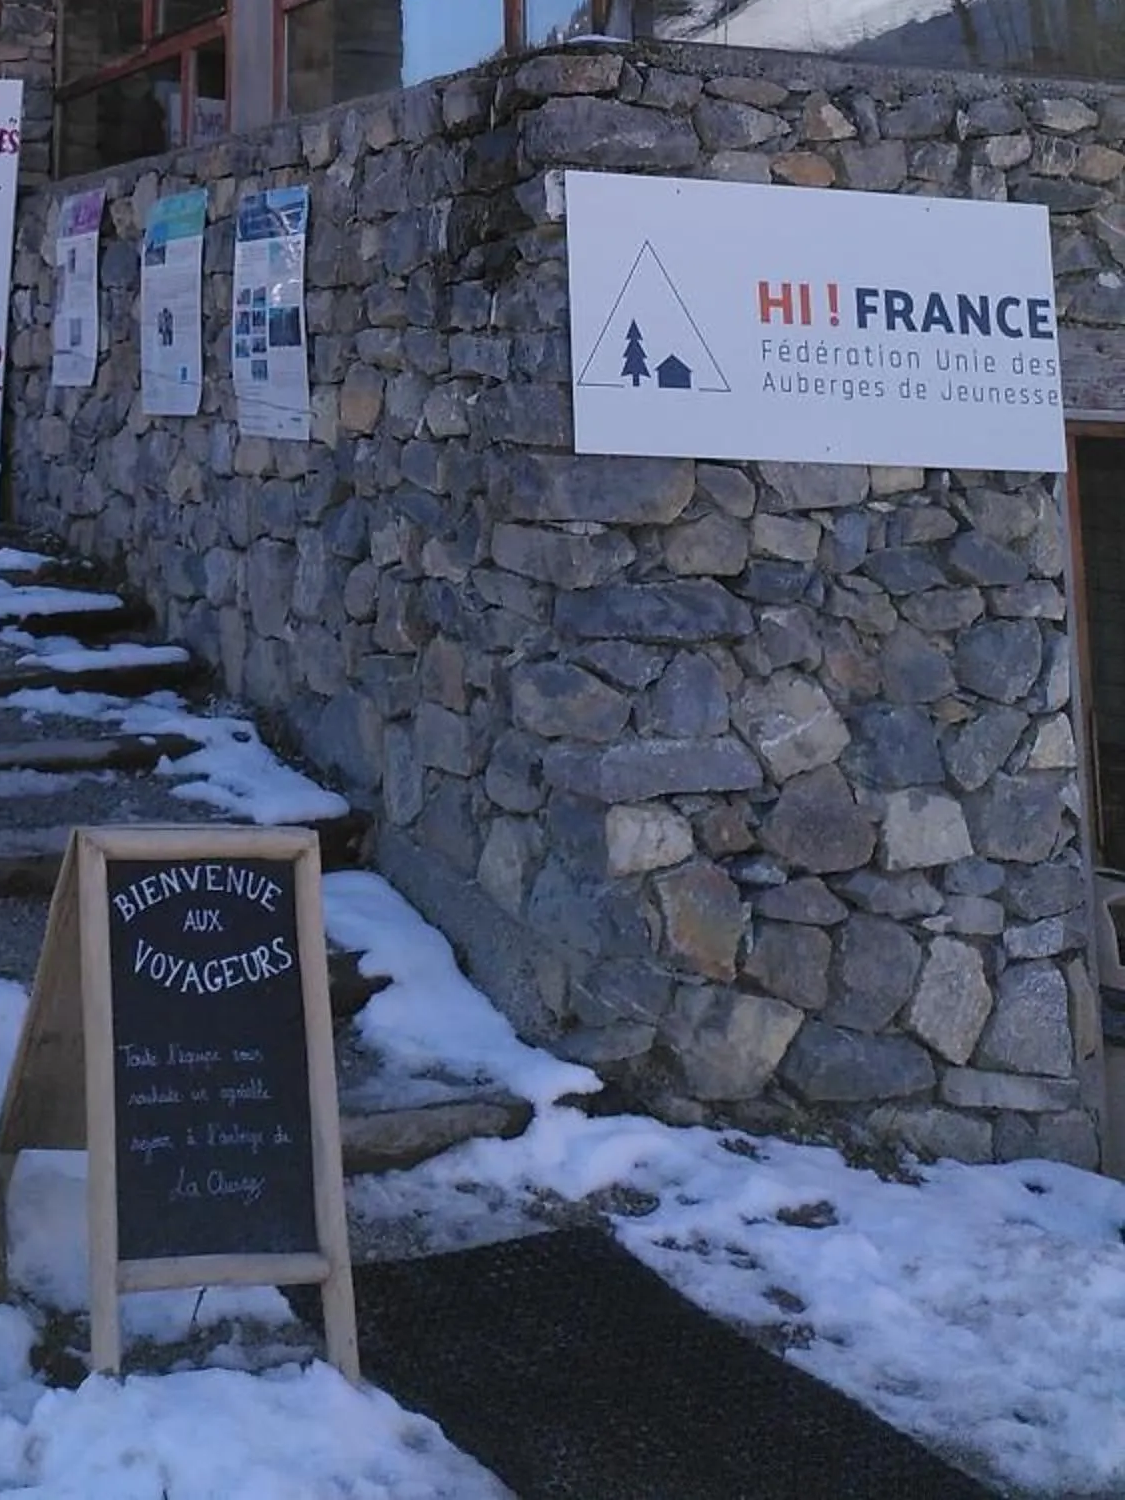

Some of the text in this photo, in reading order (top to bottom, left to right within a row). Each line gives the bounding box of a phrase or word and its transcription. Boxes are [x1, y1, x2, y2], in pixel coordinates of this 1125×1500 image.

[855, 287, 1055, 340] FRANCE
[761, 338, 1058, 377] Fédération Unie des
[761, 371, 1060, 407] Auberges de Jeunesse
[113, 863, 283, 924] BIENVENUE
[182, 908, 224, 933] AUX
[132, 936, 295, 995] VOYAGEURS
